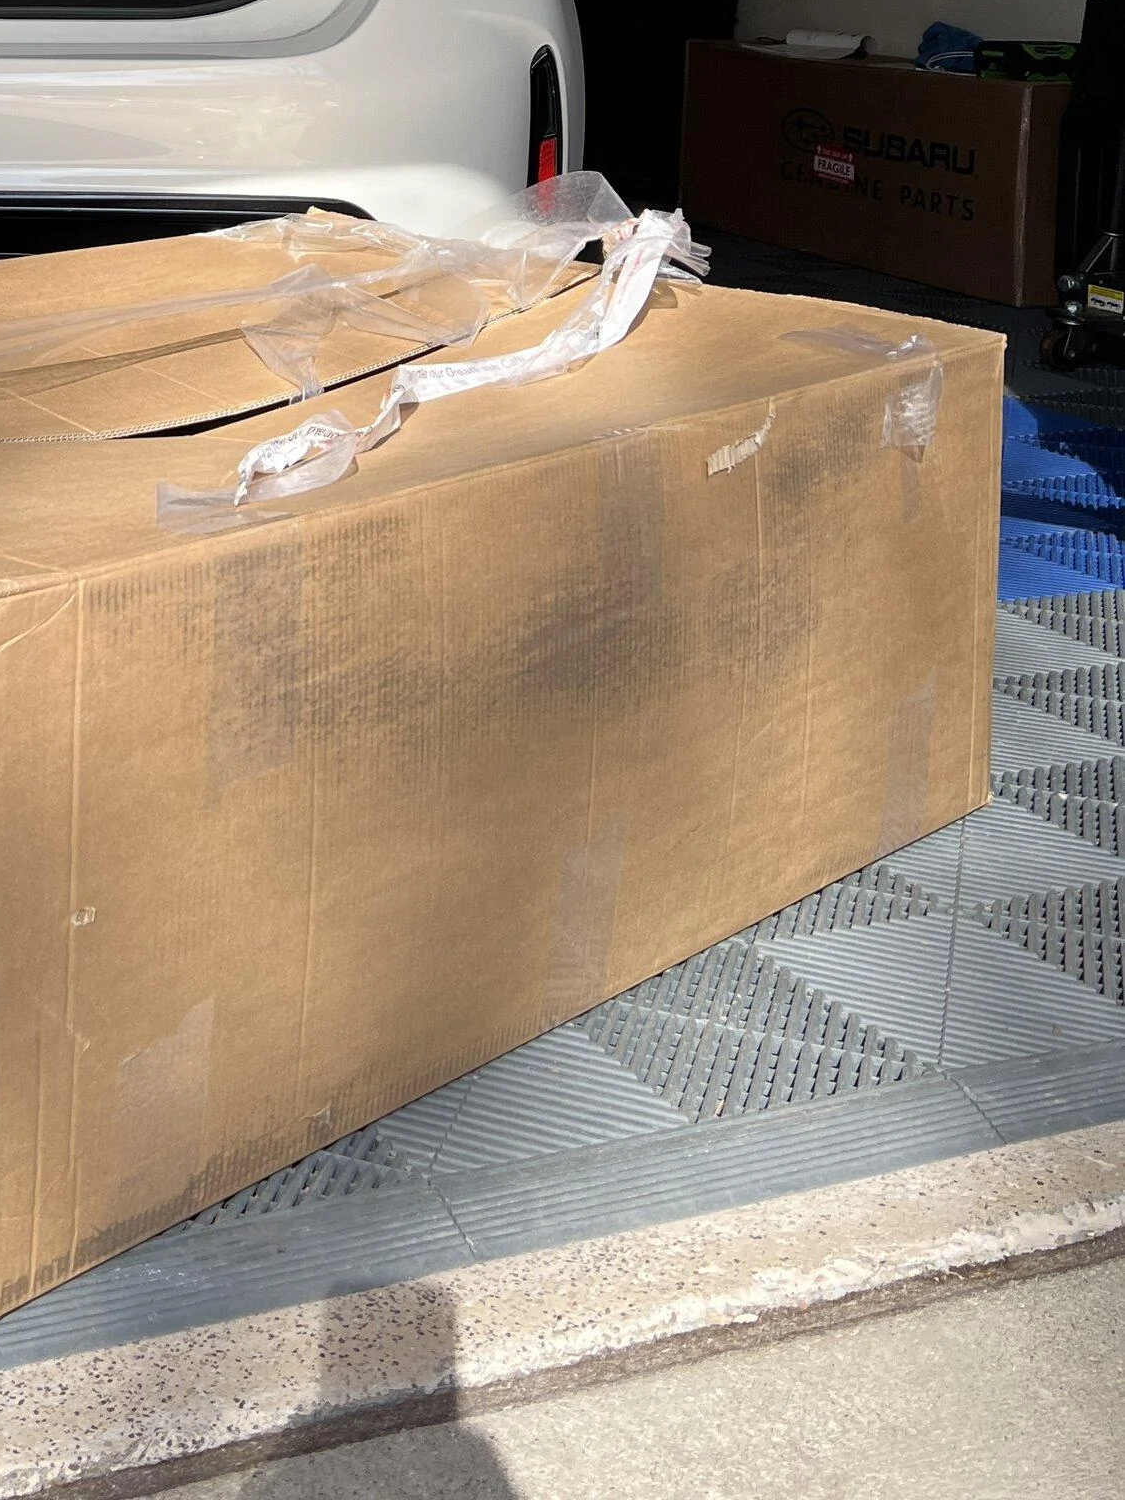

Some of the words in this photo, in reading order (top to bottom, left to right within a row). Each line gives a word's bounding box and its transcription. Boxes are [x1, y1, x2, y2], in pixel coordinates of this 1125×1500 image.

[818, 158, 851, 177] FRAGILE
[843, 124, 976, 176] SUBARU
[900, 184, 976, 222] PARTS
